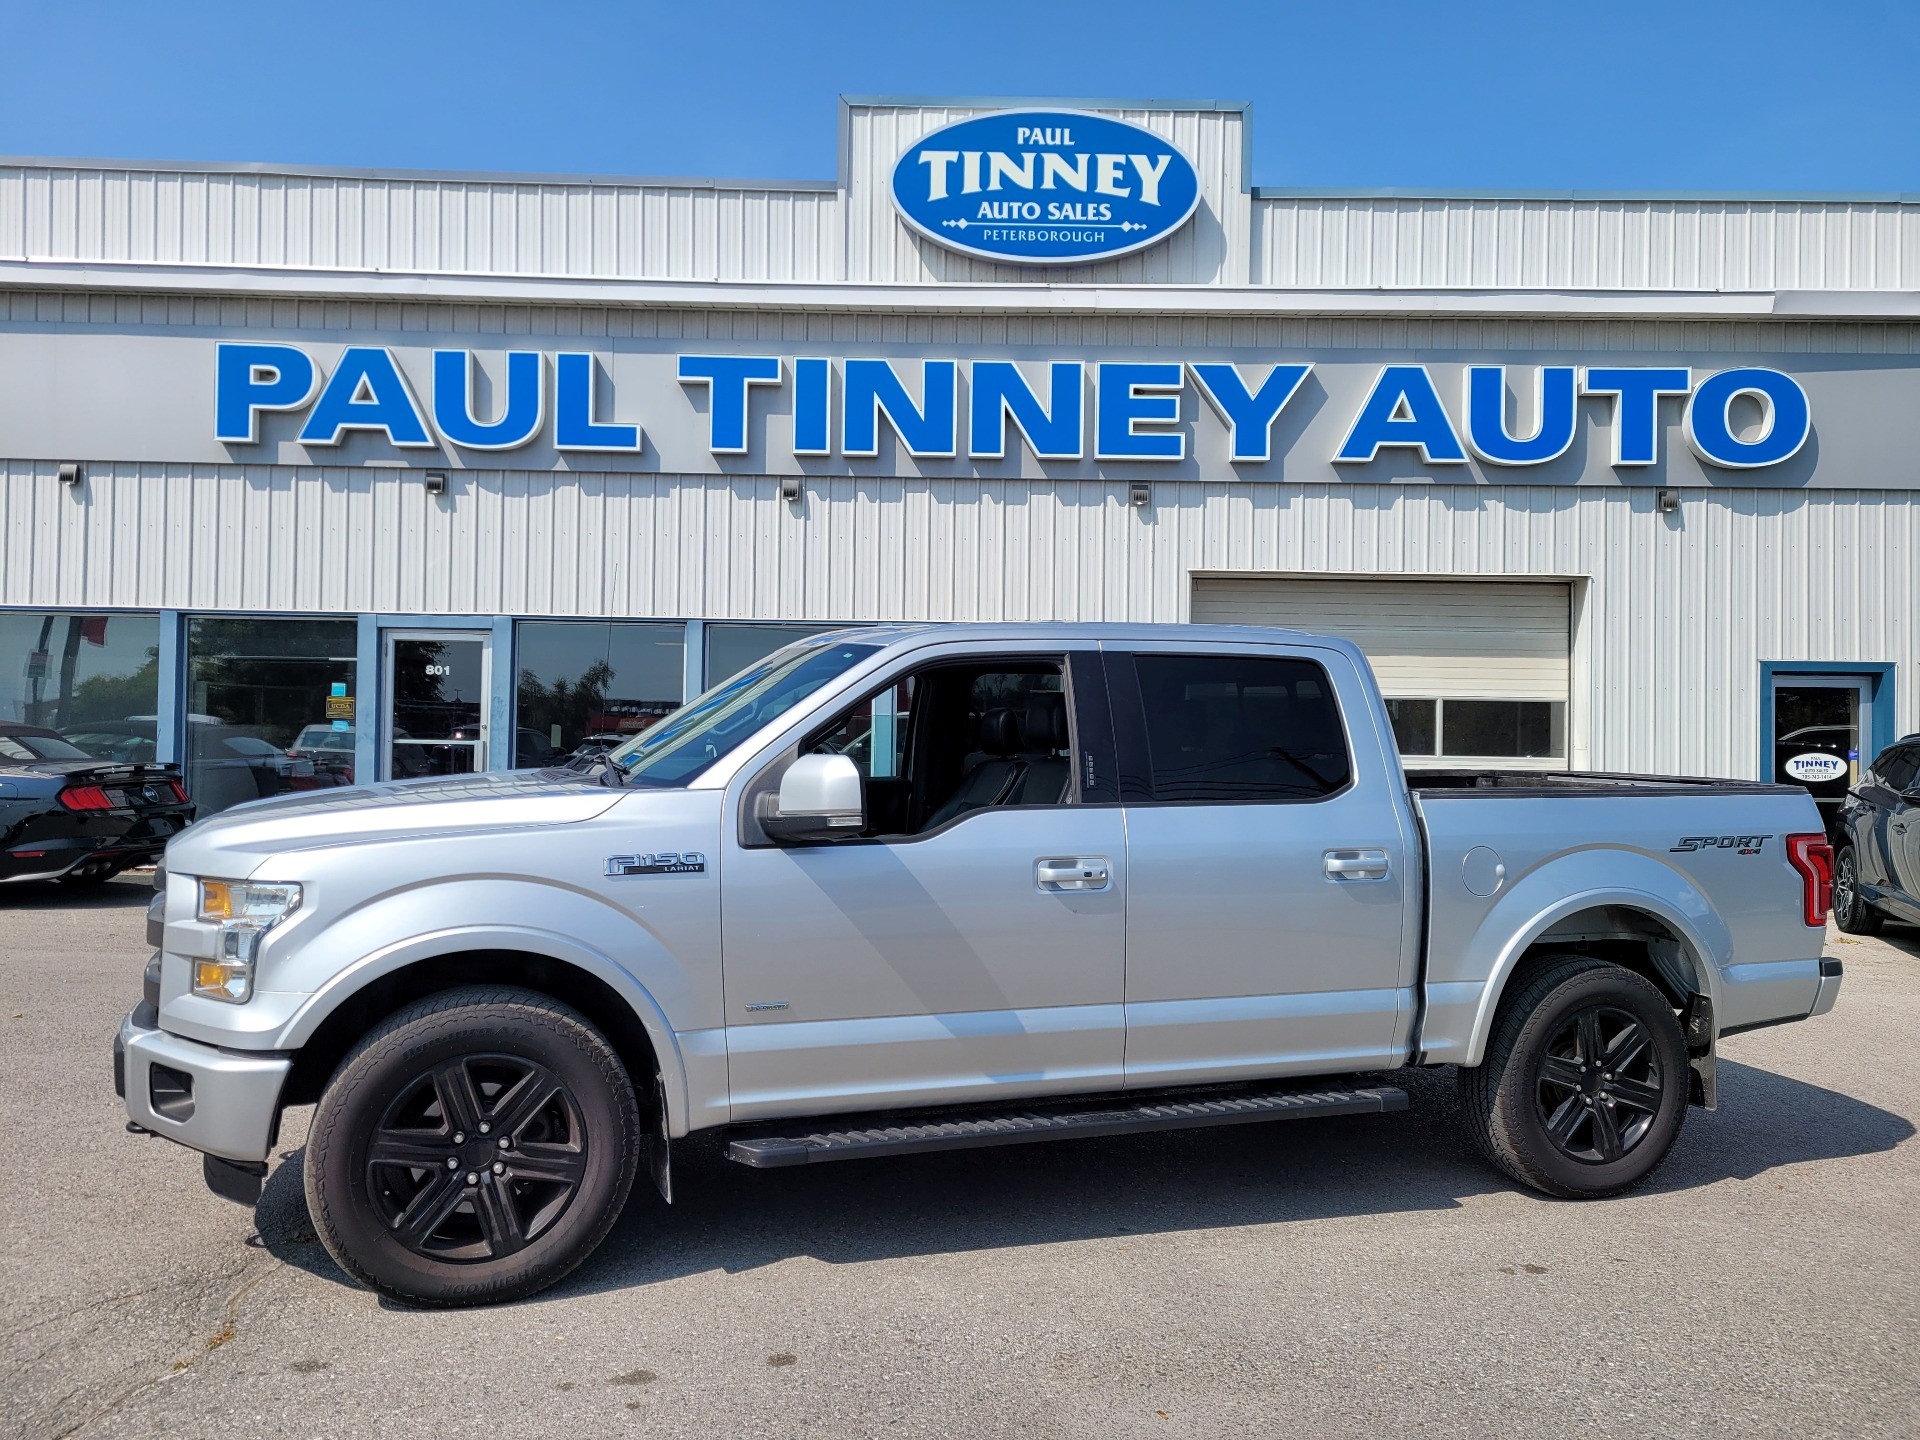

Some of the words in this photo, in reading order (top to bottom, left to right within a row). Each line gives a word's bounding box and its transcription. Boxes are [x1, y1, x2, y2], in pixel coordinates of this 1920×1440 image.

[1016, 127, 1075, 146] PAUL
[918, 150, 1172, 206] TINNEY
[976, 201, 1041, 219] AUTO
[1047, 202, 1112, 221] SALES
[983, 229, 1105, 243] PETERBOROUGH
[214, 341, 642, 453] PAUL
[676, 354, 1315, 463] TINNEY
[1331, 363, 1811, 469] AUTO
[425, 664, 450, 676] 801
[1793, 760, 1839, 771] TINNEY
[1669, 834, 1773, 852] SPORT
